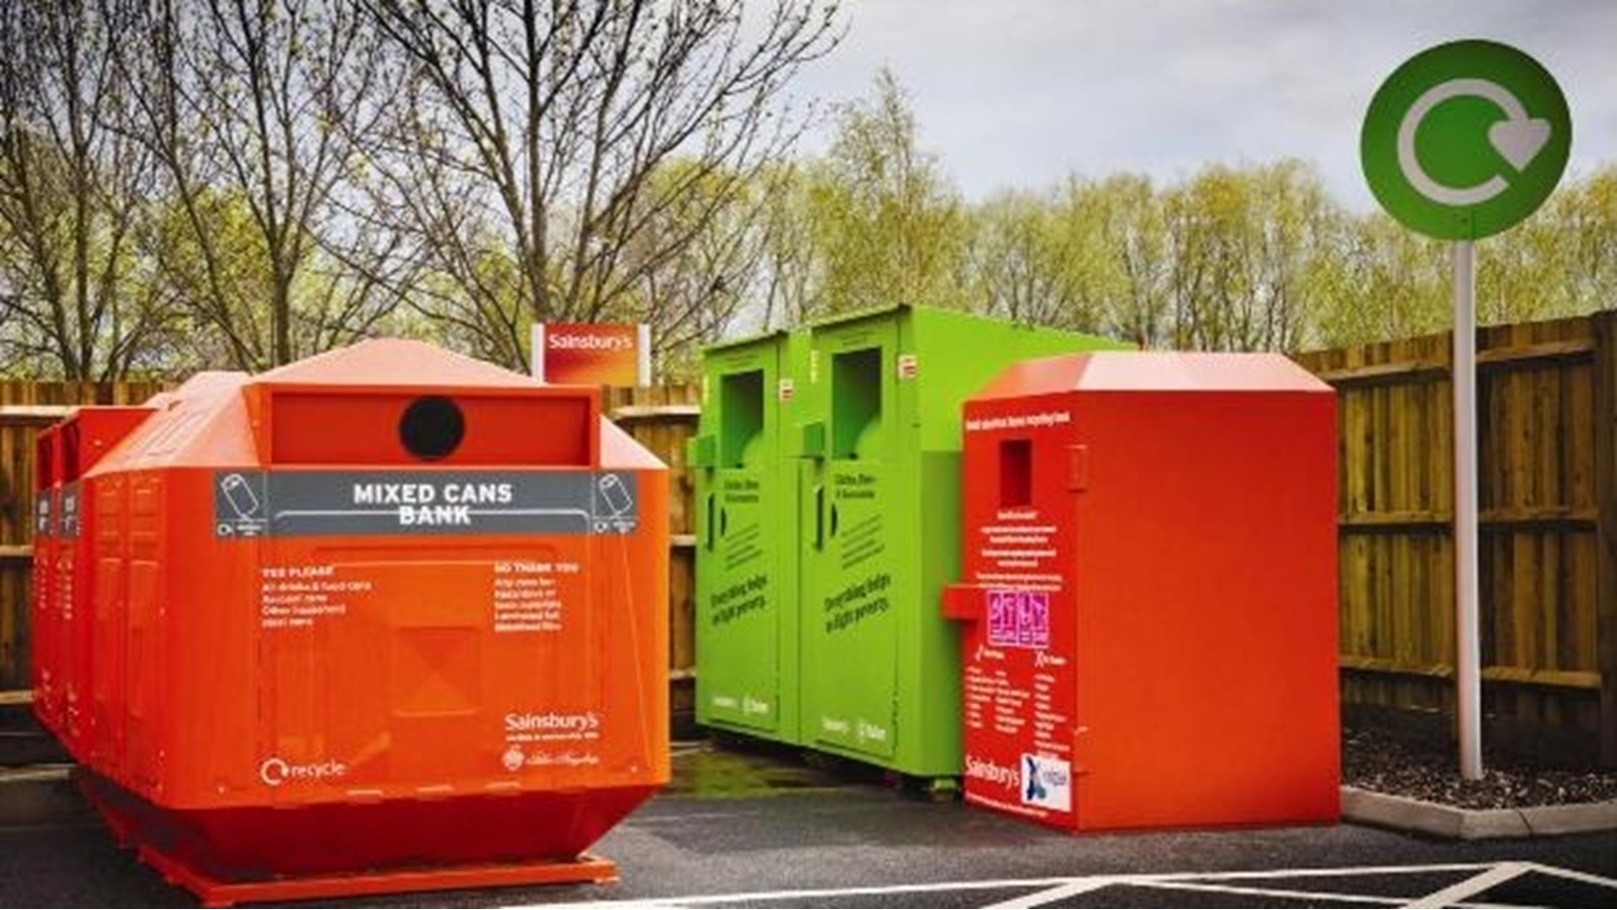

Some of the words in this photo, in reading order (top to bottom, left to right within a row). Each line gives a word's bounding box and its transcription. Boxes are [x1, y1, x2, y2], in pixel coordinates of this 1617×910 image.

[548, 334, 633, 352] Sainsbury's
[353, 483, 435, 504] MIXED
[443, 483, 513, 504] CANS
[400, 505, 471, 526] BANK
[262, 567, 286, 578] YES
[288, 564, 334, 578] PLEASE
[514, 562, 551, 574] THANK
[554, 562, 580, 574] YOU
[505, 711, 599, 732] Sainsbury's
[291, 758, 346, 779] recycle
[964, 753, 1021, 792] Sainsbury's
